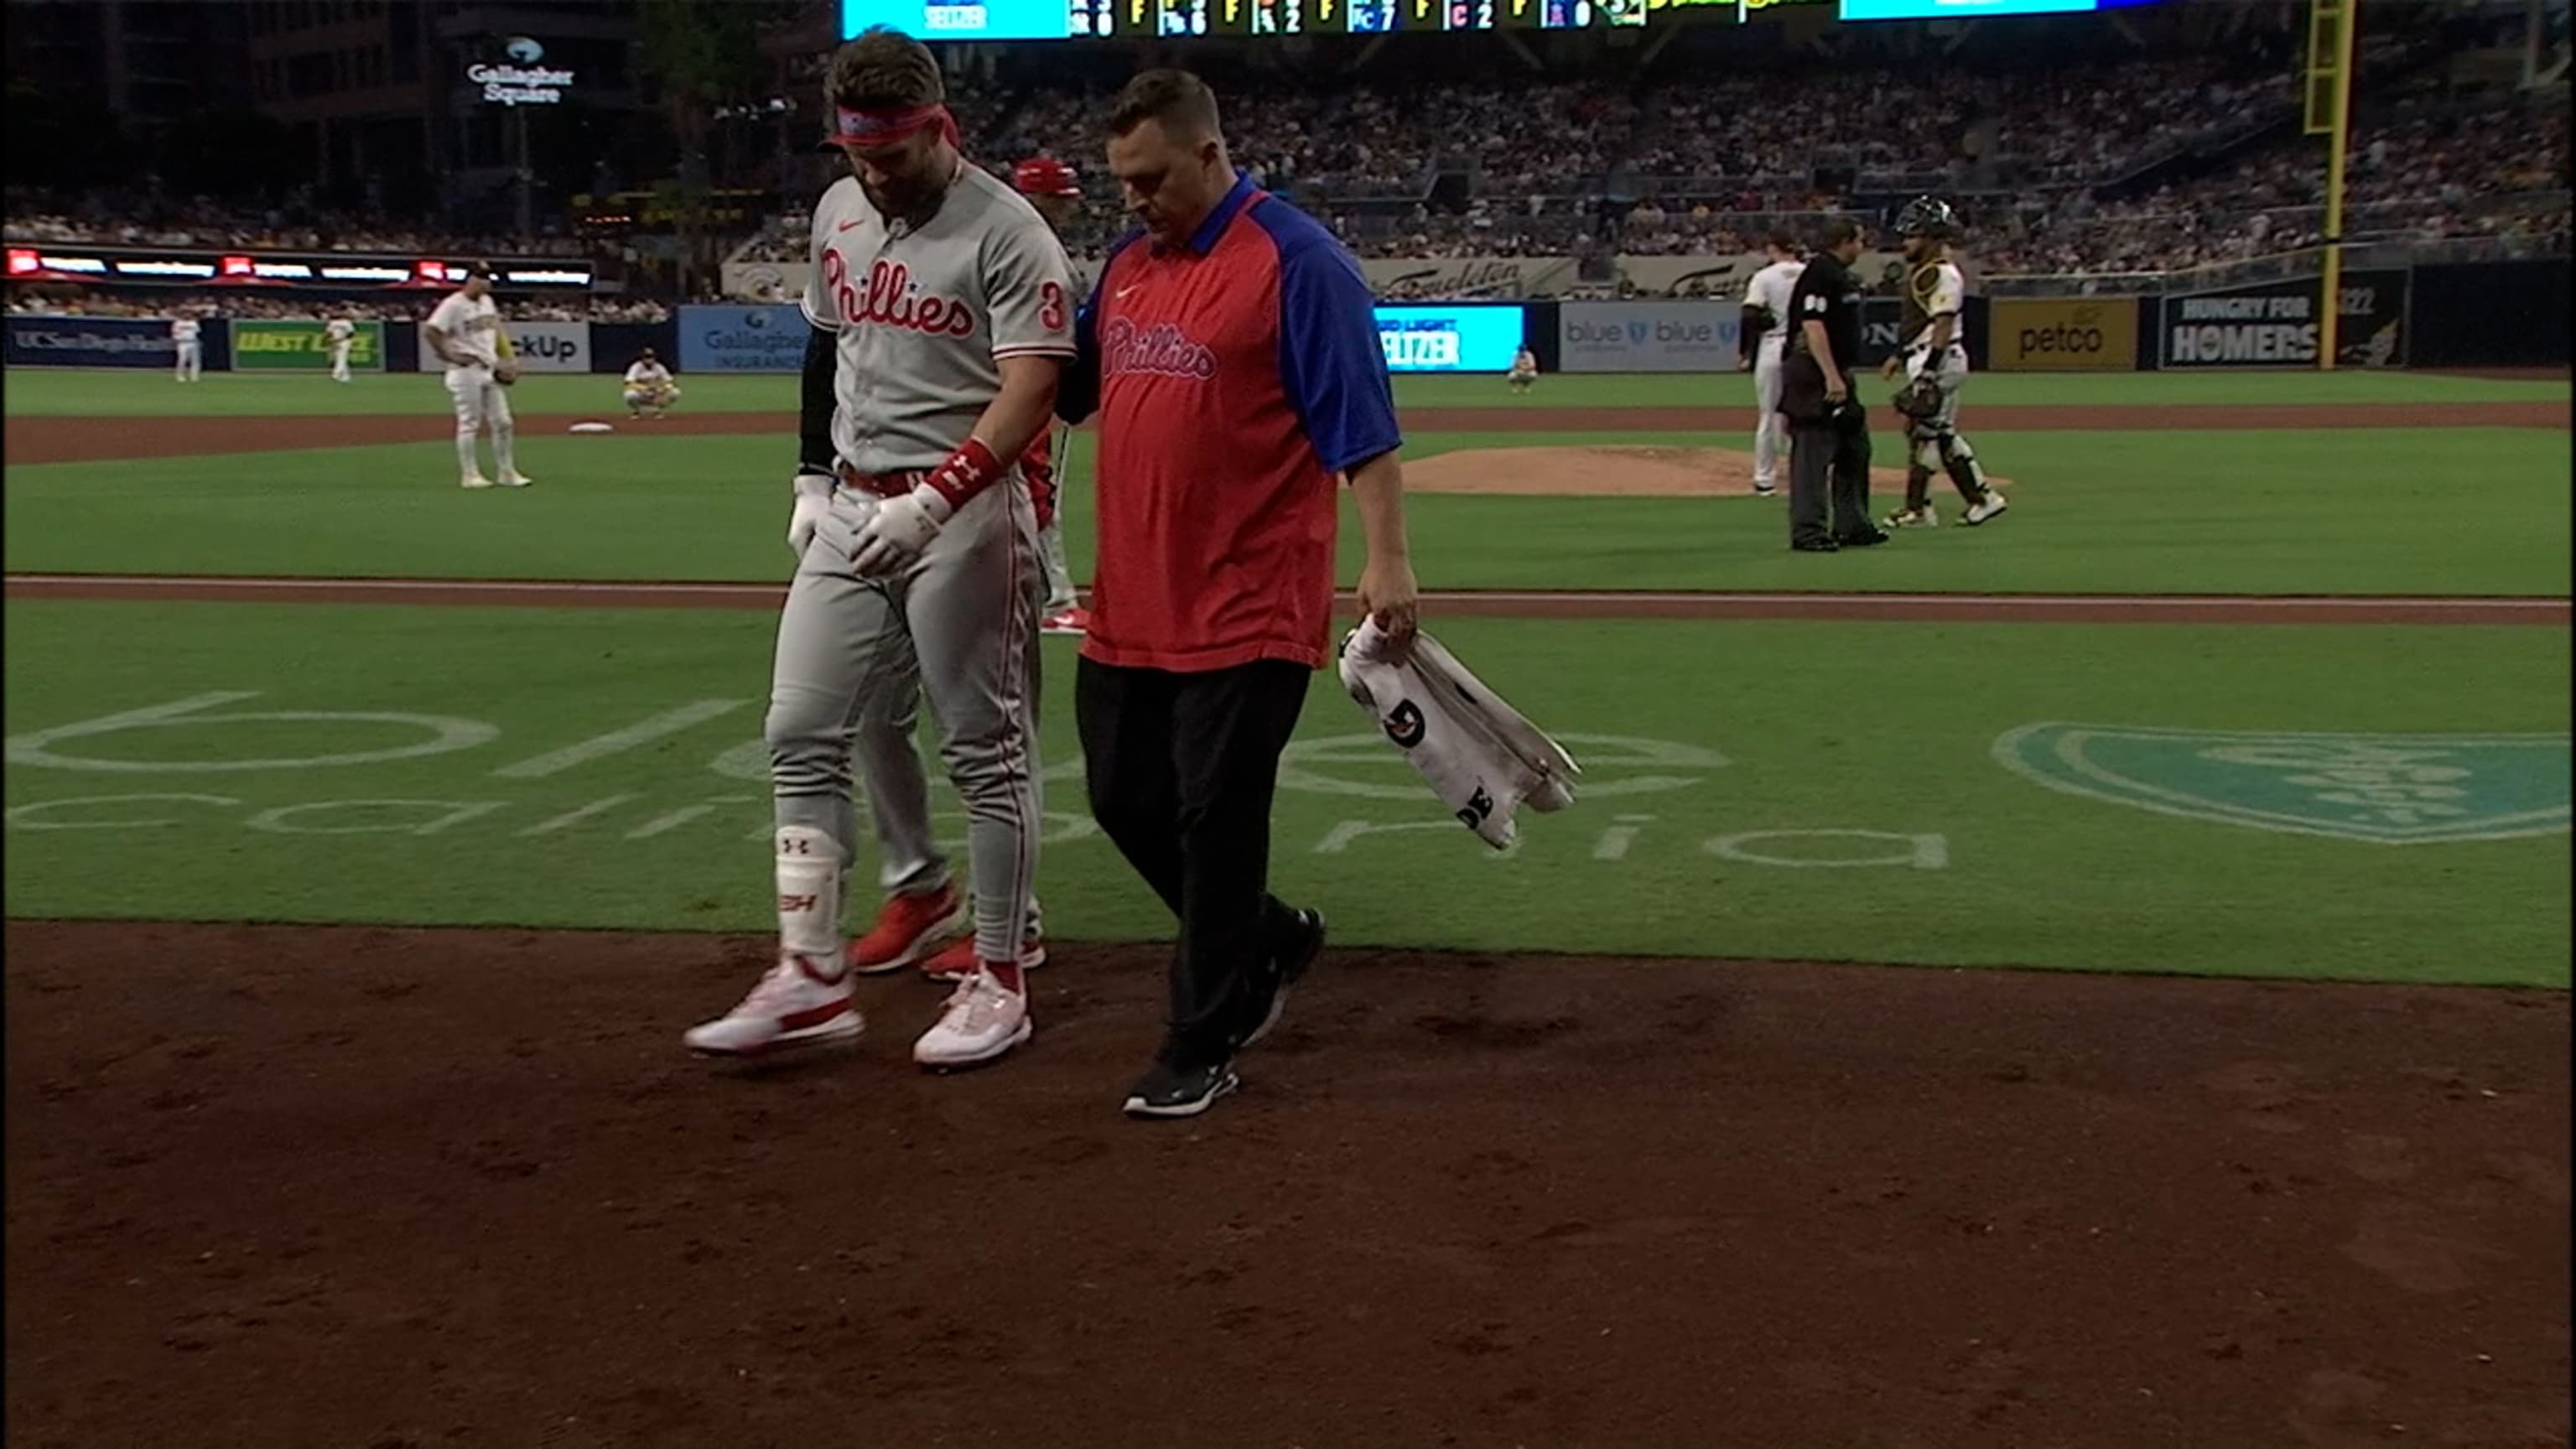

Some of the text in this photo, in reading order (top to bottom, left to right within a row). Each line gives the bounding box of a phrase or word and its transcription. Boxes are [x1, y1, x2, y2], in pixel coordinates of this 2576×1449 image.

[467, 63, 574, 87] Gallagher
[484, 83, 560, 106] Square
[818, 247, 976, 337] Phillies
[1039, 279, 1068, 332] 3
[2182, 293, 2309, 319] HUNGRY FOR
[1566, 319, 1622, 342] blue
[1656, 319, 1711, 342] blue
[2019, 325, 2103, 358] petco
[2172, 324, 2317, 361] HOMERS
[1101, 314, 1218, 381] Phillies
